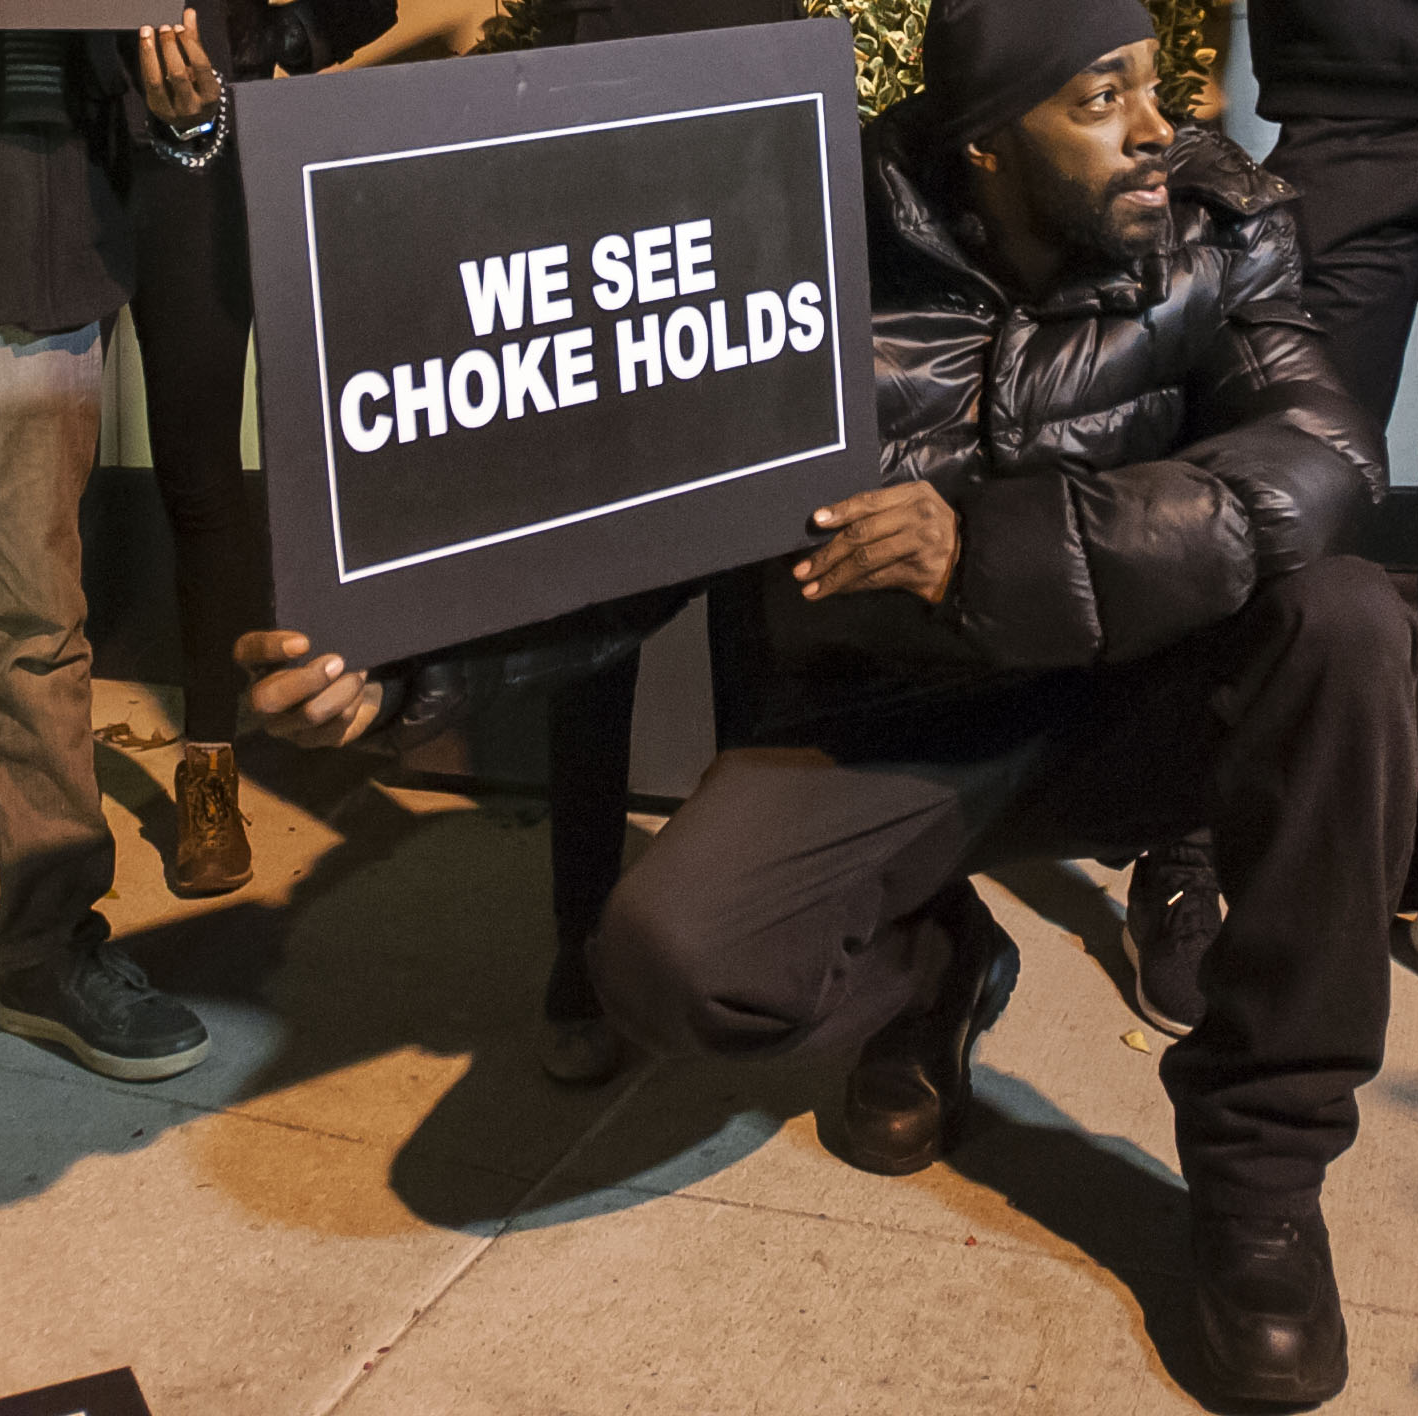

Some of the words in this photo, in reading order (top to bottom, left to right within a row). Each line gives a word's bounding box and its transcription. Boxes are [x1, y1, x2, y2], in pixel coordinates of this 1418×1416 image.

[459, 244, 573, 337] WE
[591, 219, 716, 311] SEE
[340, 327, 599, 453] CHOKE
[615, 281, 825, 394] HOLDS
